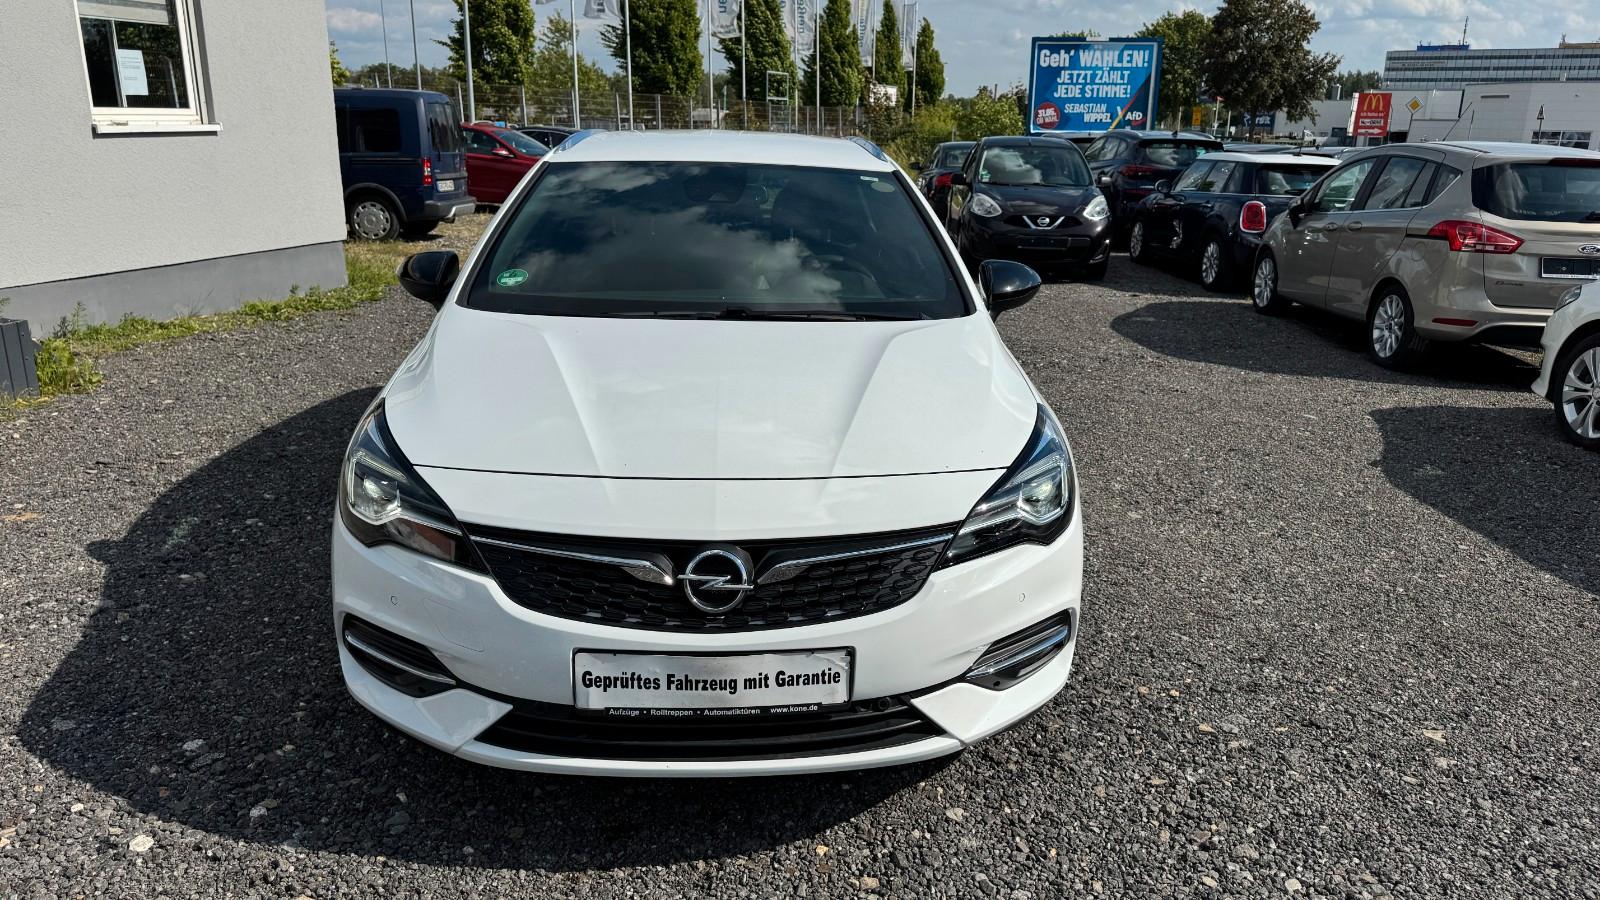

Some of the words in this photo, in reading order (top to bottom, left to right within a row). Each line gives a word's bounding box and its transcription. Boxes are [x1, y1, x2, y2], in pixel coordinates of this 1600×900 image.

[1079, 45, 1149, 67] WÄHLEN!
[1057, 70, 1092, 83] JETZT
[1095, 67, 1130, 83] ZÄHLT
[1054, 85, 1082, 97] JEDE
[1085, 85, 1131, 97] STIMME!
[1064, 103, 1107, 113] SEBASTIAN
[1084, 113, 1112, 123] WIPPEL
[1125, 111, 1143, 120] AfD
[582, 671, 660, 692] Geprüftes
[667, 674, 737, 695] Fahrzeug
[744, 672, 769, 690] mit
[775, 668, 840, 687] Garantie
[609, 708, 640, 717] Aufzüge
[651, 709, 693, 717] Rolltreppen
[704, 708, 760, 716] Automatiktüren
[770, 705, 818, 714] www.kone.de
